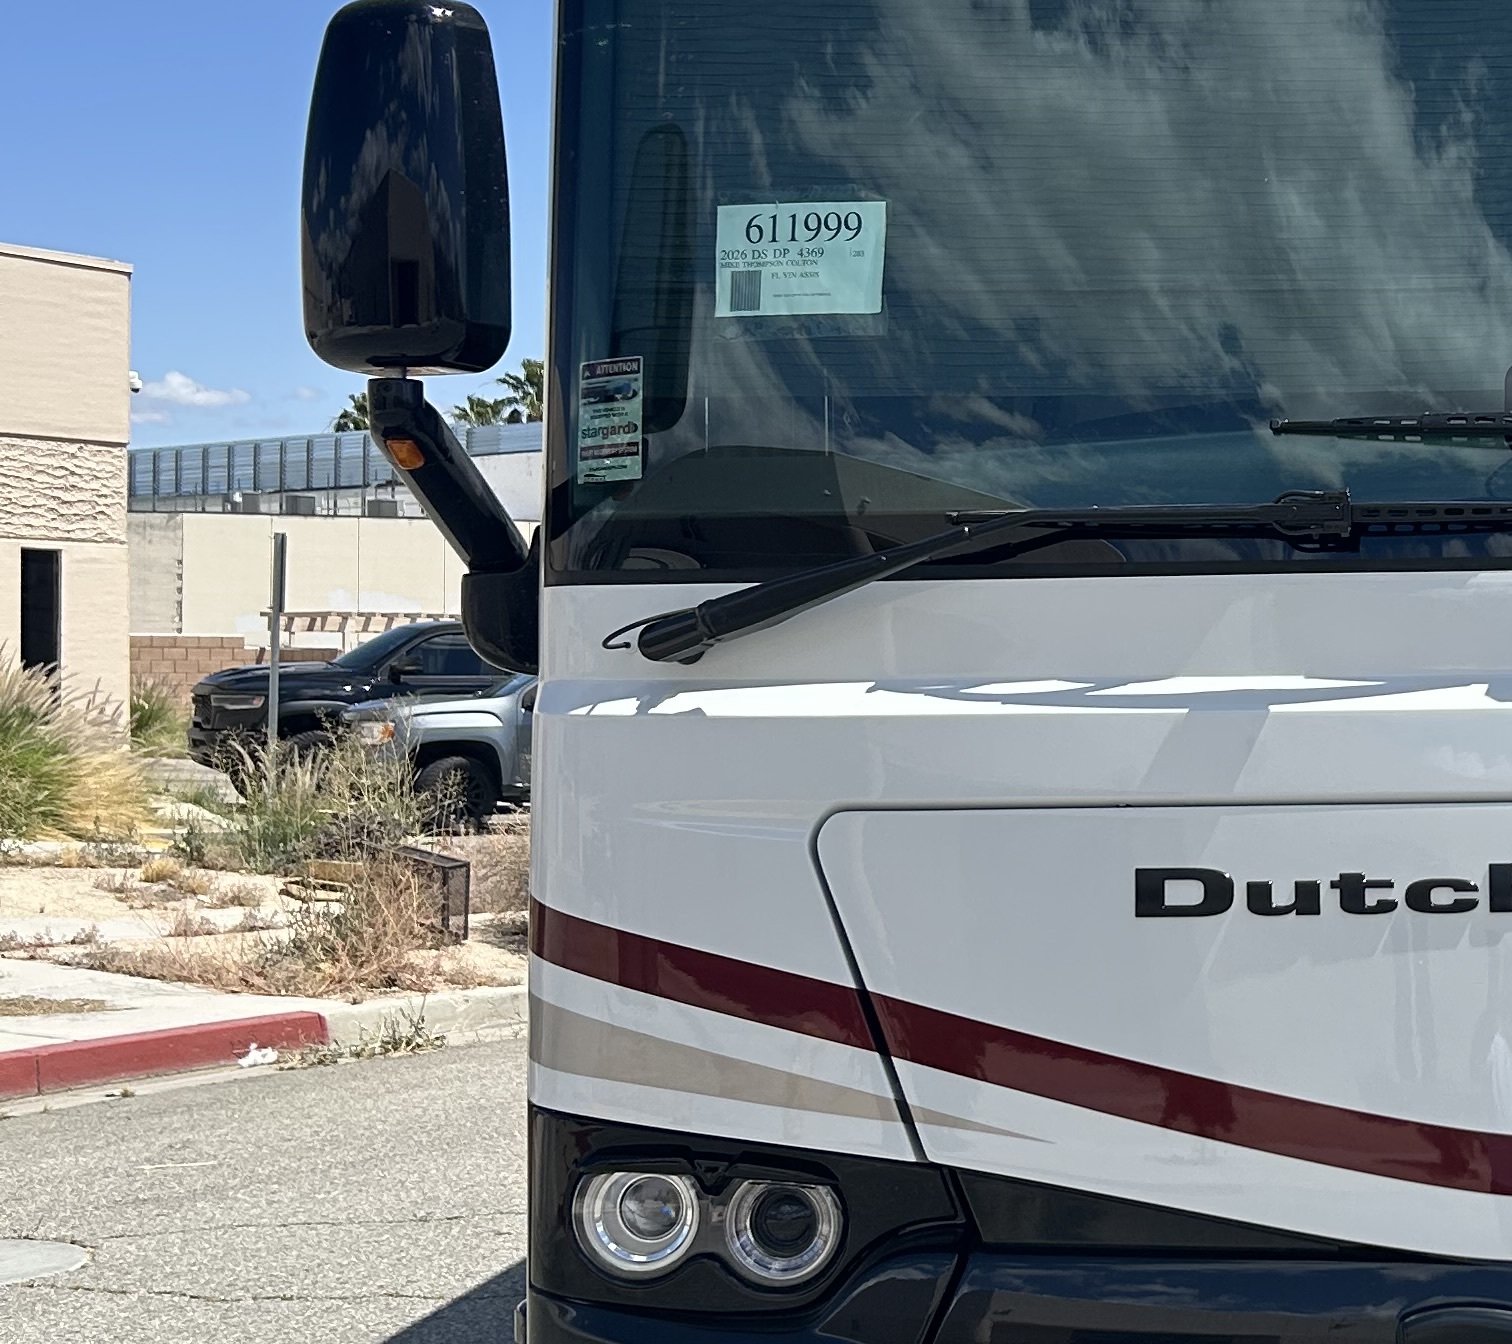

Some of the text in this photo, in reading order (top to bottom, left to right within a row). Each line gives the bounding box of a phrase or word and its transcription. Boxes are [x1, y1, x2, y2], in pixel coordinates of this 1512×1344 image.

[745, 211, 863, 244] 611999
[720, 247, 825, 261] 2026 DS DP 4369
[596, 361, 639, 375] ATTENTION
[581, 421, 632, 440] stargard
